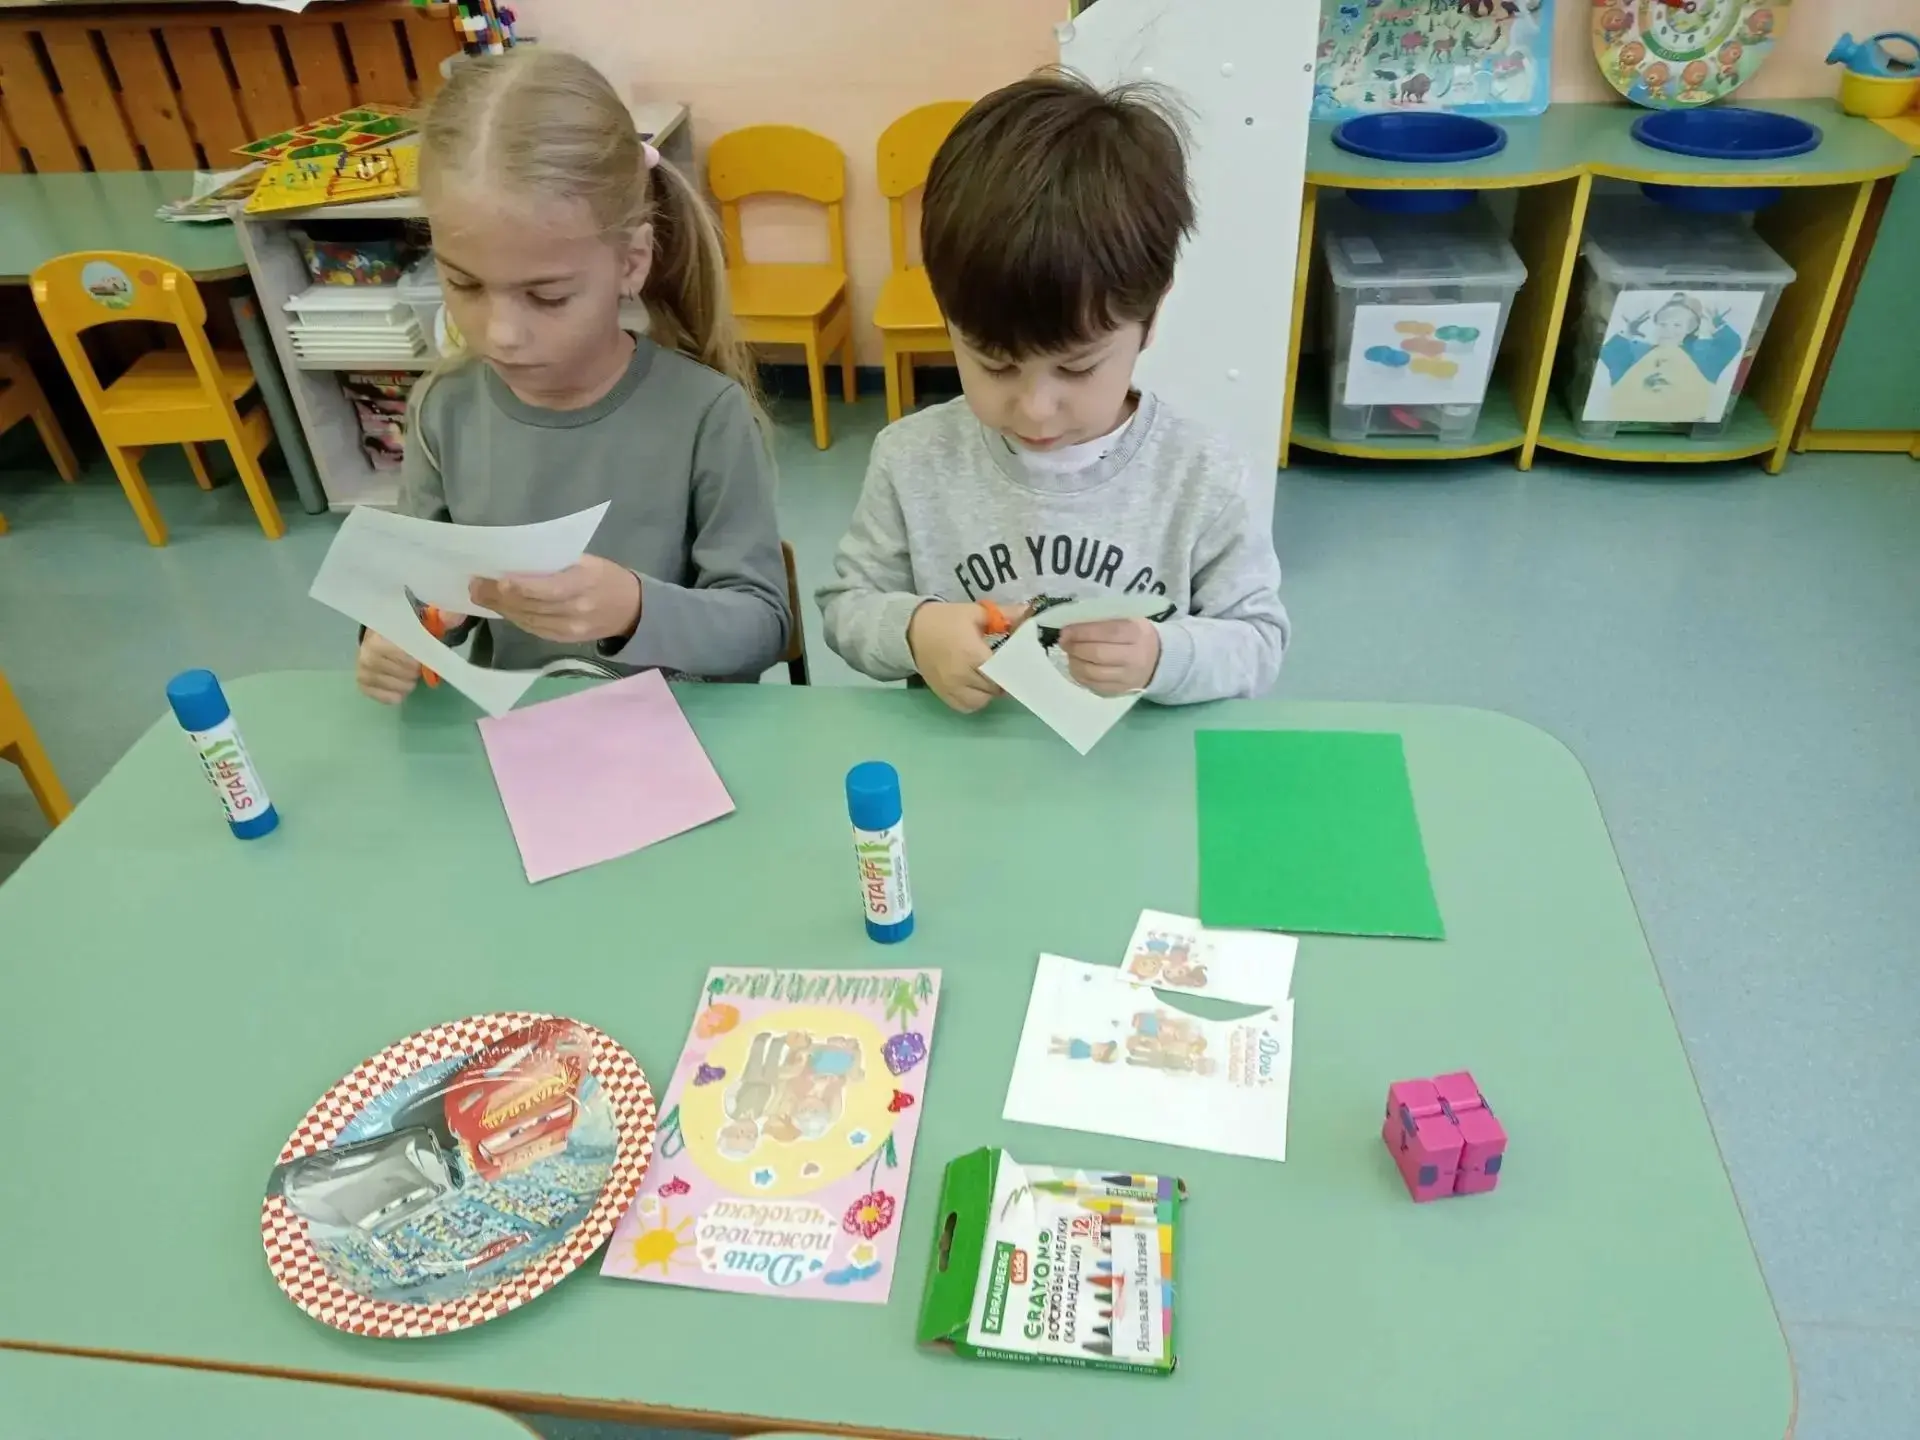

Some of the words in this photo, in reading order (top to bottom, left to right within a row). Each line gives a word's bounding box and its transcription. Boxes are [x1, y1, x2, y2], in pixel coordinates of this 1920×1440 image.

[954, 542, 1018, 602] FOR
[1025, 534, 1124, 588] YOUR
[215, 760, 253, 810] STAFF
[864, 858, 888, 914] STAFF
[702, 1224, 832, 1250] пожилого
[713, 1201, 825, 1226] человека
[1071, 1216, 1091, 1238] 12
[1054, 1217, 1068, 1263] МЕЛКИ
[723, 1250, 805, 1287] День
[989, 1250, 1010, 1319] BRAUBERG
[1048, 1265, 1065, 1341] ВОСКОВЫЕ
[1063, 1245, 1082, 1344] (КАРАНДАШИ)
